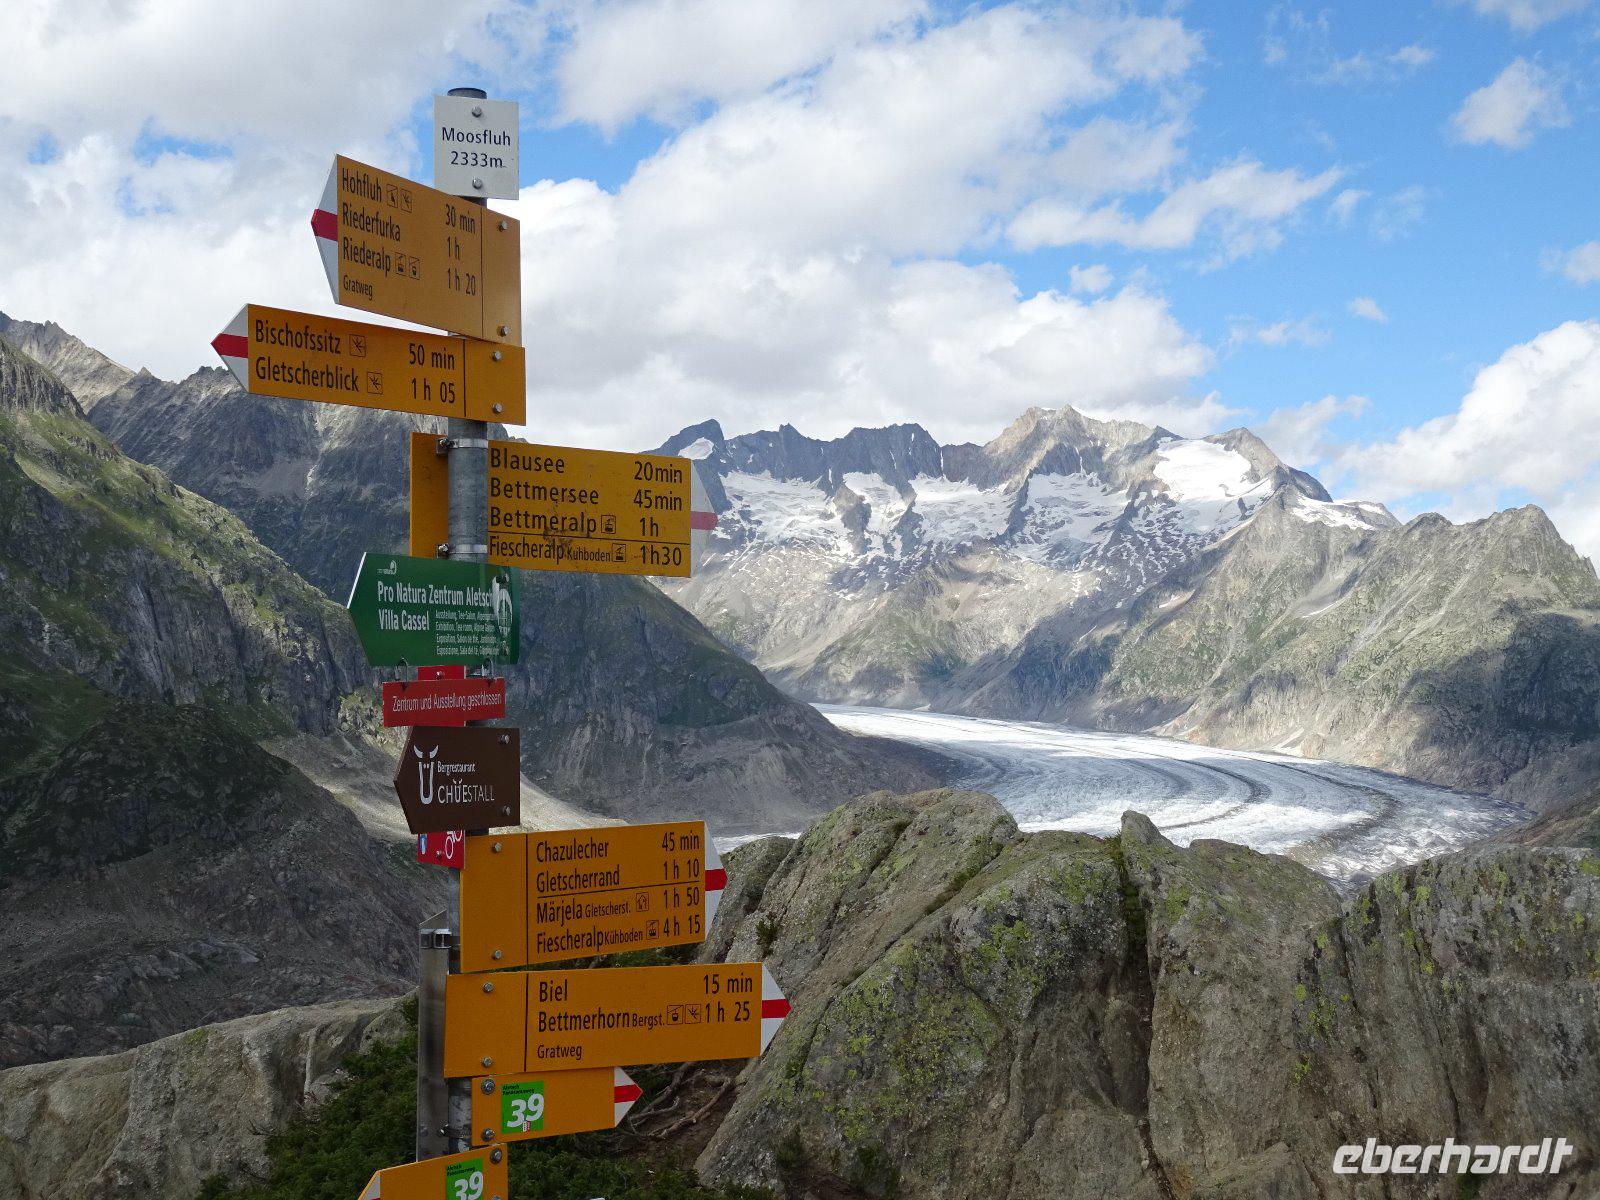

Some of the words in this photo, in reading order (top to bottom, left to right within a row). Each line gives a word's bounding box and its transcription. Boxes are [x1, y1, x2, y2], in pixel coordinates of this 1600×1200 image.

[442, 127, 511, 147] Moosfluh
[450, 151, 503, 169] 2333m
[342, 168, 382, 203] Hohfluh
[445, 204, 456, 226] 30
[460, 211, 475, 234] min
[343, 202, 400, 242] Riederfurka
[447, 237, 451, 258] 1
[454, 240, 460, 260] h
[343, 237, 391, 277] Riederalp
[447, 270, 451, 289] 1
[454, 271, 460, 292] h
[465, 274, 476, 296] 20
[343, 274, 373, 300] Gratweg
[255, 319, 341, 355] Bischofssitz
[409, 344, 425, 366] 50
[431, 347, 455, 371] min
[255, 357, 359, 392] Gletscherblick
[411, 378, 417, 399] 1
[424, 379, 431, 402] h
[440, 382, 455, 404] 05
[491, 448, 565, 473] Blausee
[491, 478, 599, 504] Bettmersee
[491, 507, 597, 538] Bettmeralp
[489, 536, 564, 565] Fiescheralp
[378, 581, 393, 602] Pro
[397, 583, 427, 604] Natura
[428, 584, 463, 606] Zentrum
[378, 609, 399, 630] Villa
[401, 611, 430, 631] Cassel
[393, 696, 419, 712] Zentrum
[420, 694, 432, 710] und
[433, 693, 466, 711] Ausstellung
[467, 692, 501, 710] geschlossen
[437, 761, 475, 776] Bergrestaurant
[536, 837, 609, 862] Chazulecher
[662, 832, 675, 852] 45
[680, 830, 700, 850] min
[536, 864, 620, 893] Gletscherrand
[664, 861, 668, 880] 1
[673, 860, 680, 879] h
[687, 859, 699, 878] 10
[537, 898, 582, 927] Märjela
[584, 900, 631, 917] Gletscherst.
[664, 890, 668, 909] 1
[673, 888, 680, 908] h
[686, 887, 699, 906] 50
[537, 925, 604, 954] Fiescheralp
[604, 928, 643, 946] Kühboden
[663, 918, 669, 937] 4
[673, 917, 680, 936] h
[688, 915, 700, 934] 15
[539, 979, 567, 1002] Biel
[703, 974, 719, 995] 15
[727, 972, 753, 993] min
[538, 1007, 630, 1033] Bettmerhorn
[632, 1013, 665, 1030] Bergst.
[705, 1003, 711, 1023] 1
[717, 1002, 725, 1022] h
[734, 1001, 750, 1022] 25
[537, 1043, 582, 1061] Gratweg
[507, 1093, 545, 1128] 39
[454, 1171, 484, 1200] 39
